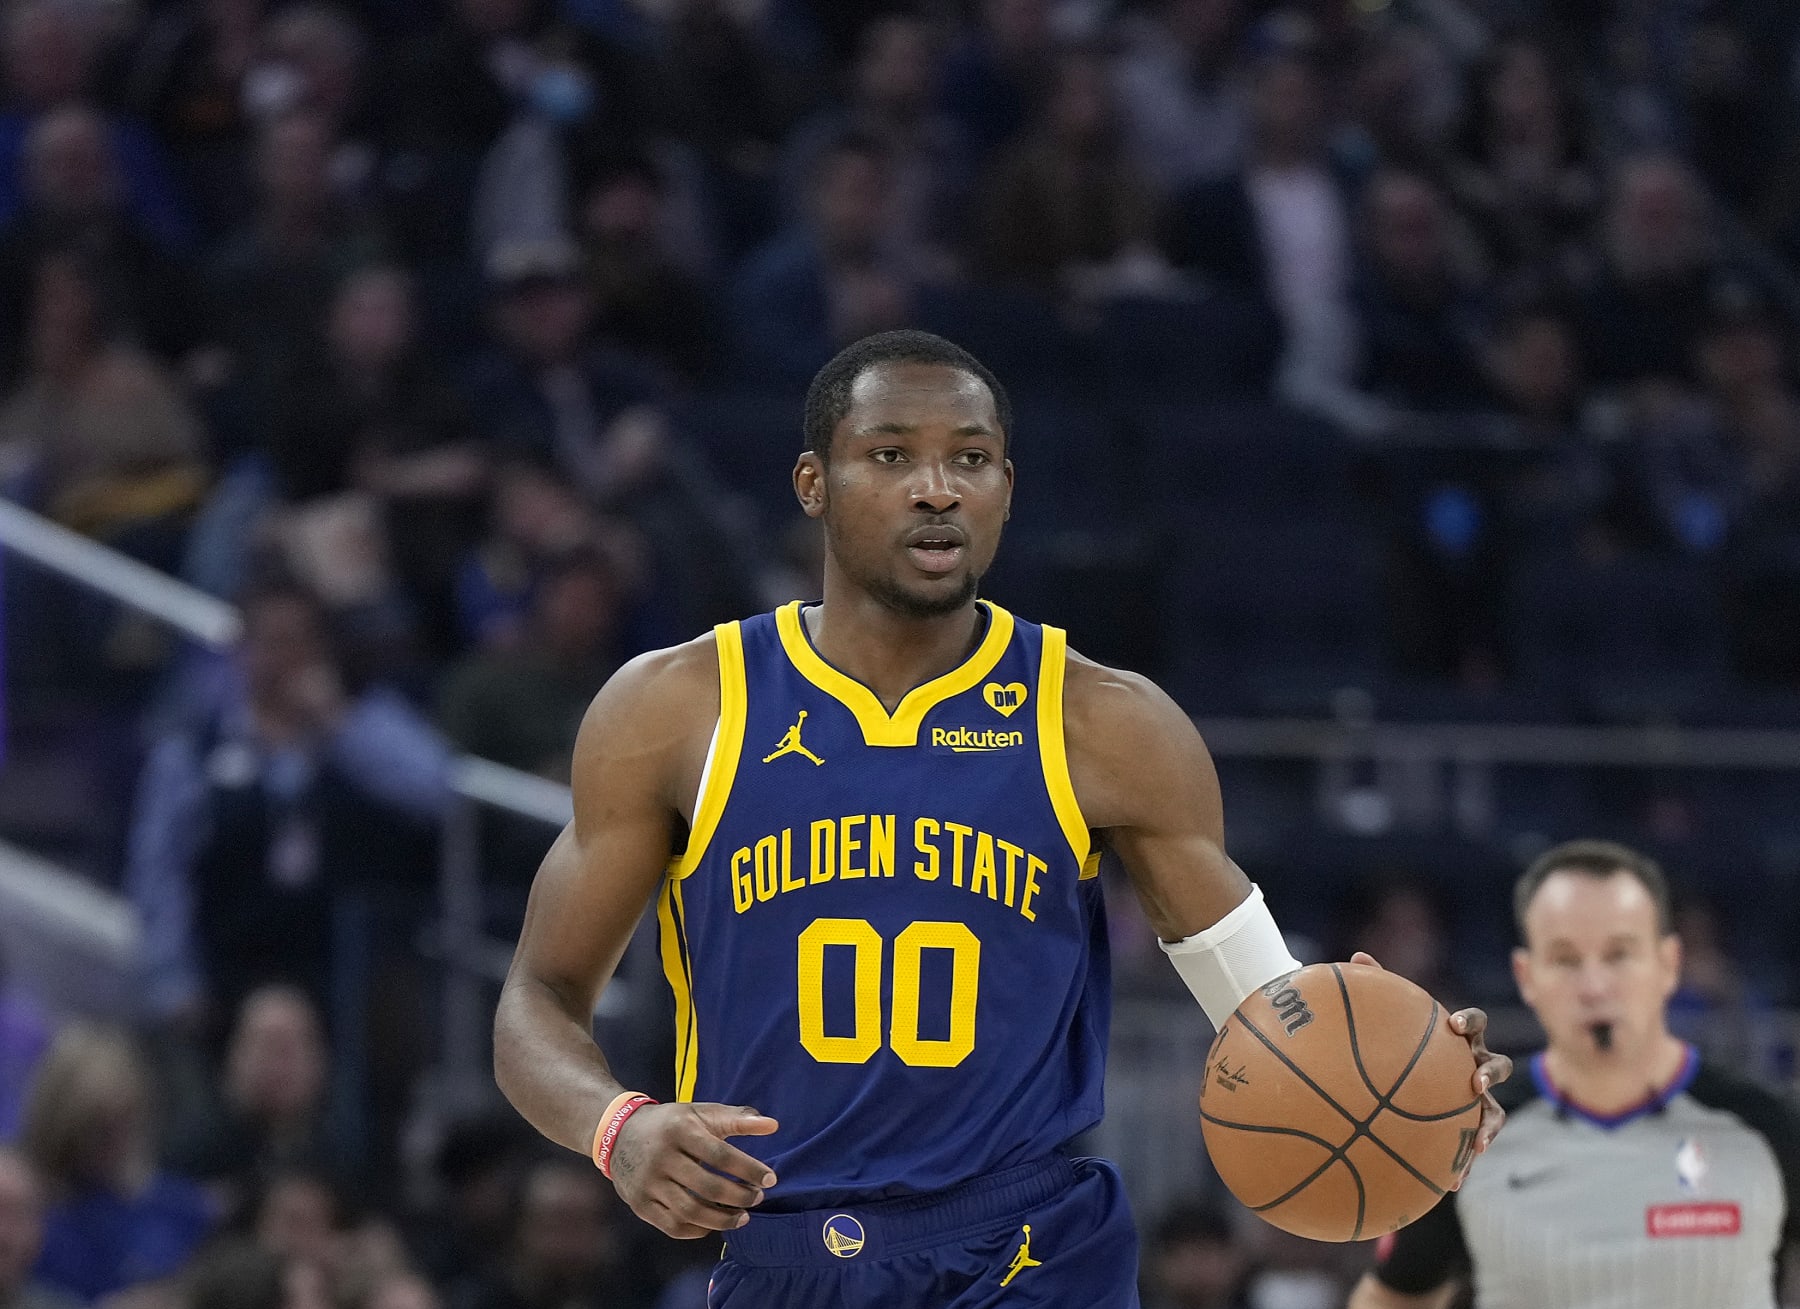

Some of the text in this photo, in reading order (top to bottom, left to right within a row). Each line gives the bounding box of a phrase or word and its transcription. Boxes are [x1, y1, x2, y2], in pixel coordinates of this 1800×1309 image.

[993, 690, 1018, 708] DM
[931, 727, 1023, 749] Rakuten
[730, 813, 1049, 923] GOLDEN STATE
[797, 917, 982, 1068] 00
